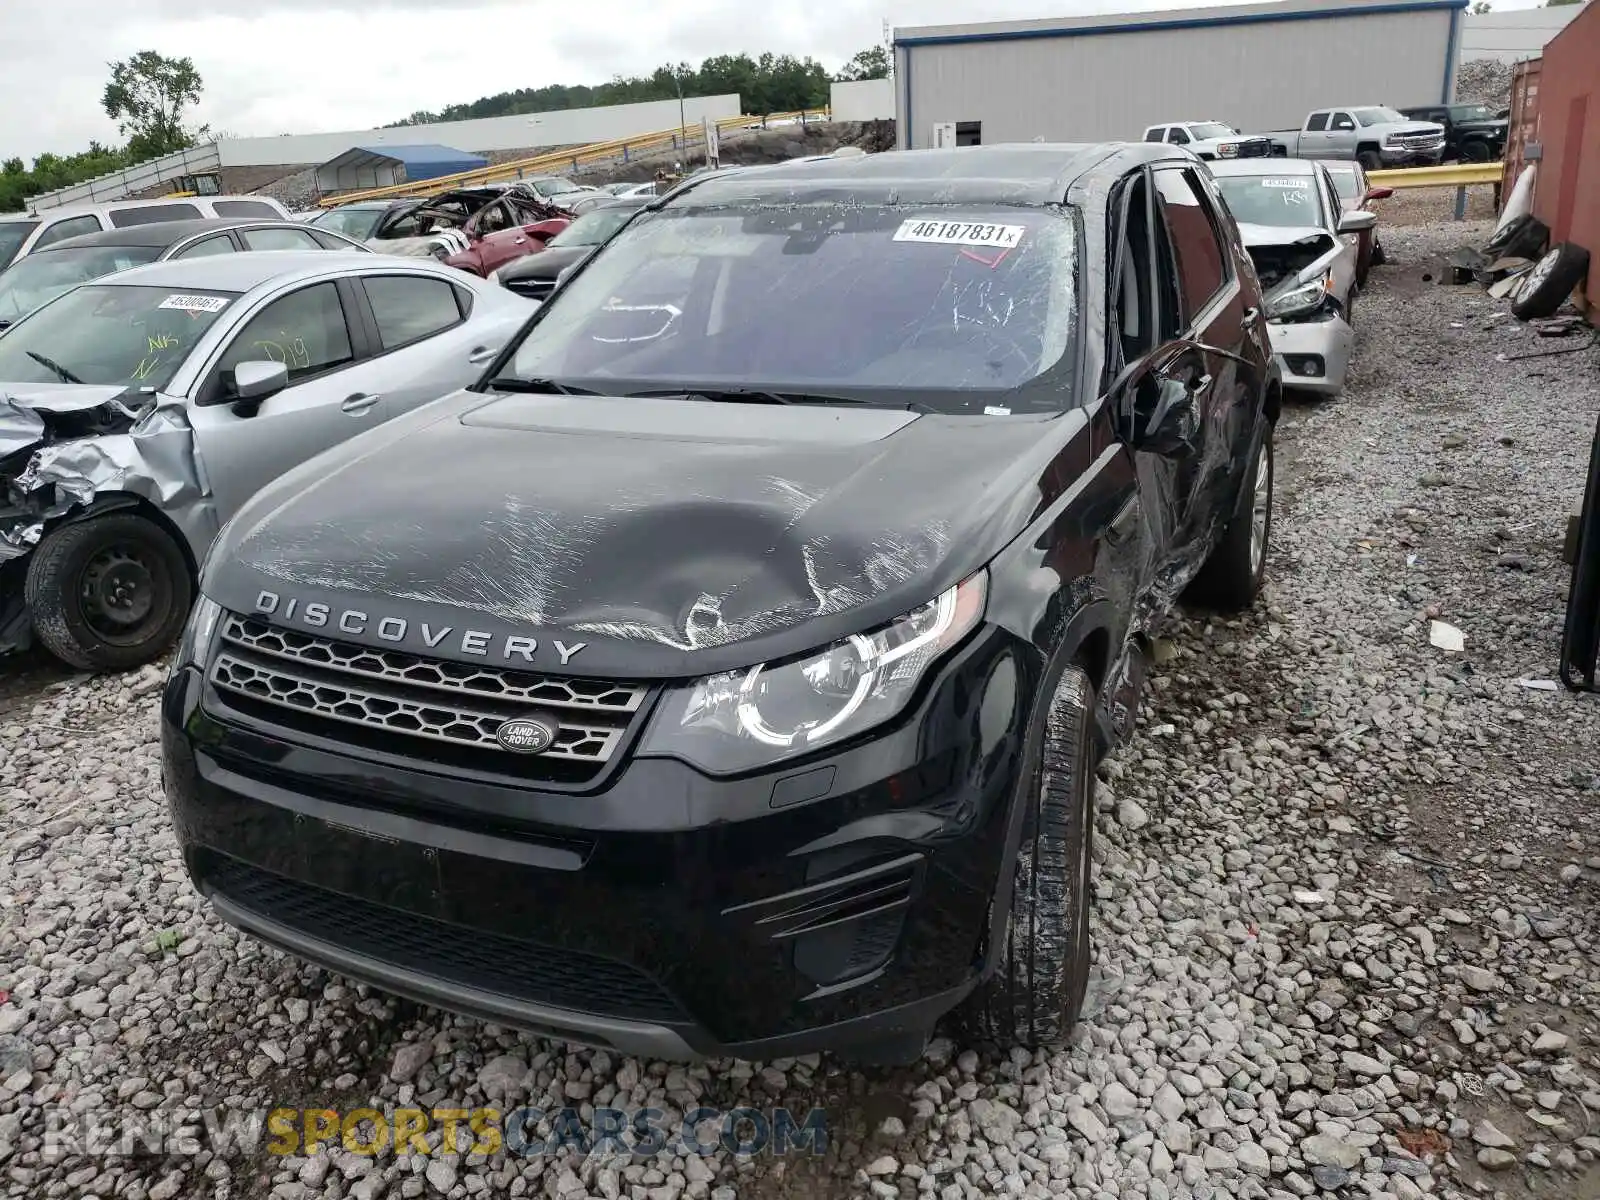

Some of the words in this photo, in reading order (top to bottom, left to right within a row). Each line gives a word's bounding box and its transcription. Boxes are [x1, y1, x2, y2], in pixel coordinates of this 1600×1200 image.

[255, 590, 586, 664] DISCOVERY
[507, 725, 534, 737] LAND
[508, 735, 540, 747] ROVER
